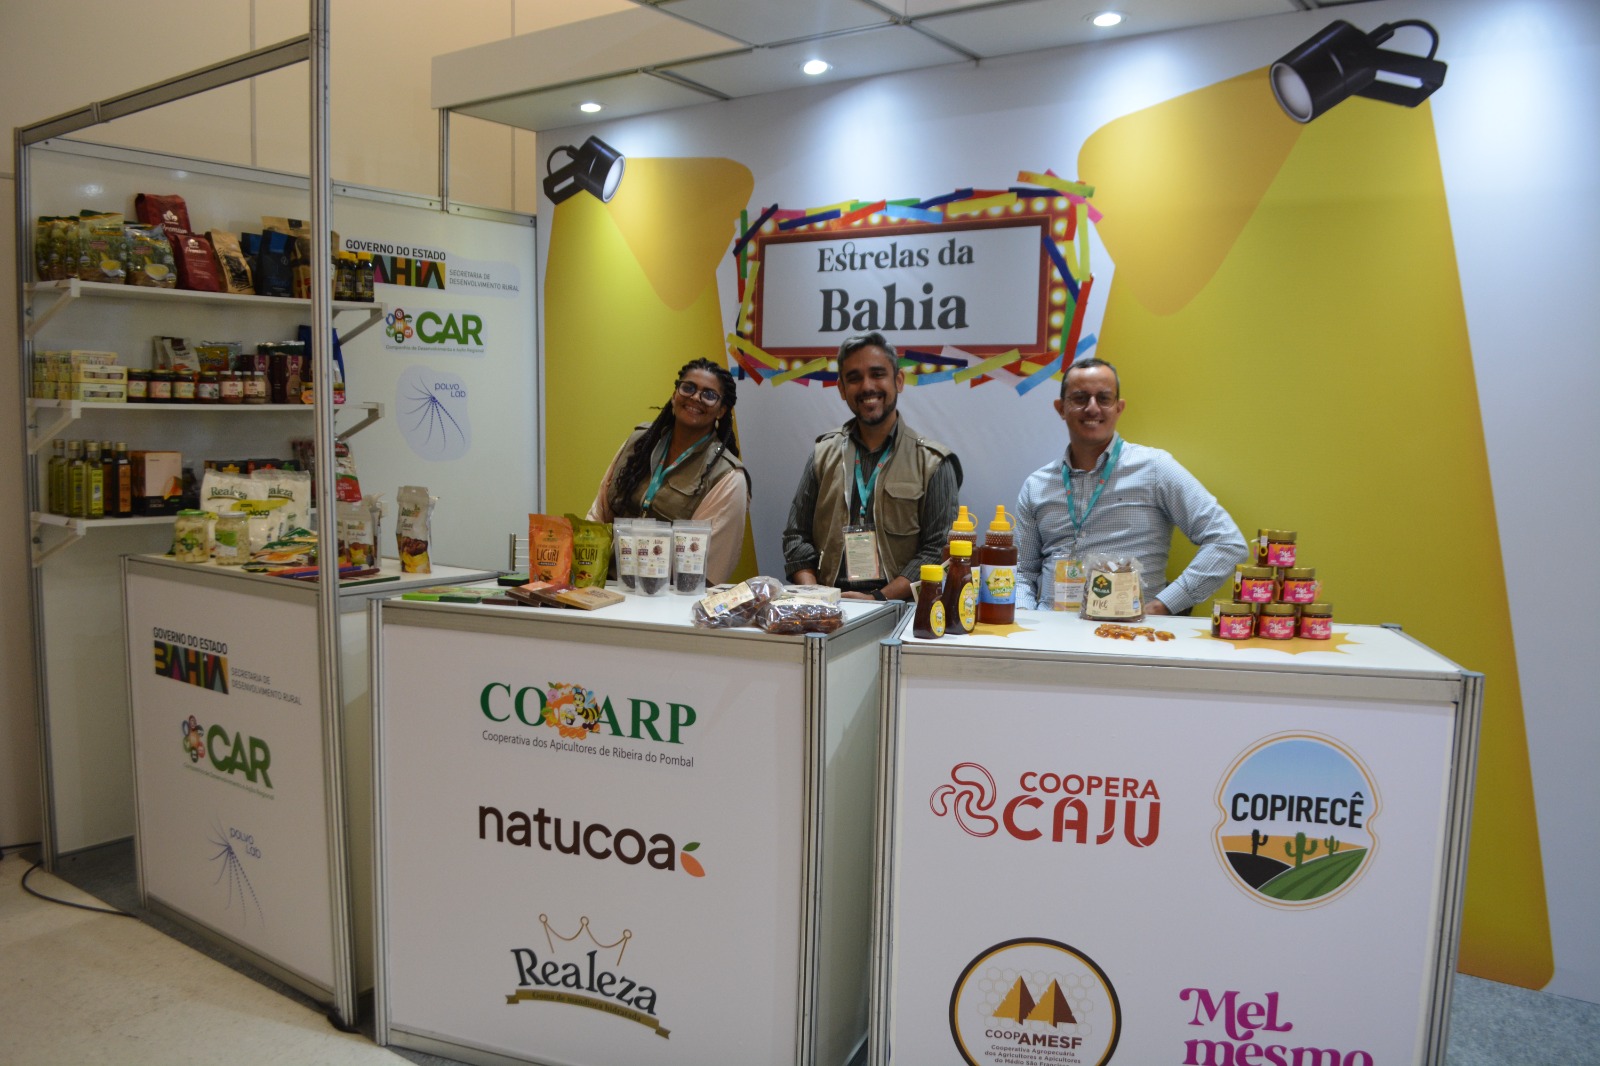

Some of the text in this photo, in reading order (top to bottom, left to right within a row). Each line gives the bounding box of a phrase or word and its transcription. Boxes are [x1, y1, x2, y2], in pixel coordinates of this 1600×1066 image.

[345, 239, 446, 261] GOVERNO DO ESTADO
[817, 237, 975, 273] Estrelas da
[372, 253, 445, 290] AHIA
[449, 269, 482, 279] SECRETARIA
[449, 277, 519, 292] DESENVOLVIMENTO RURAL
[818, 282, 969, 332] Bahia
[416, 311, 483, 345] CAR
[211, 486, 247, 500] Realza
[268, 484, 293, 498] aleza
[1092, 599, 1108, 610] Mel
[153, 627, 228, 655] GOVERNO DO ESTADO
[154, 640, 229, 695] BAHIA
[207, 724, 273, 789] CAR
[482, 730, 694, 768] Cooperativa dos Apicultores de Ribeira do Pombal
[1020, 771, 1160, 800] COOPERA
[1002, 794, 1161, 848] CAJU
[1231, 791, 1365, 829] COPIRECÊ
[479, 805, 675, 871] natucoa
[511, 948, 657, 1015] Realeza
[985, 1029, 1082, 1049] COOPAMESF
[991, 1044, 1075, 1057] Cooperativa Agropecuária
[1182, 1039, 1374, 1066] mesmo
[998, 1051, 1037, 1060] Agricultores
[1044, 1056, 1081, 1064] Apicultores
